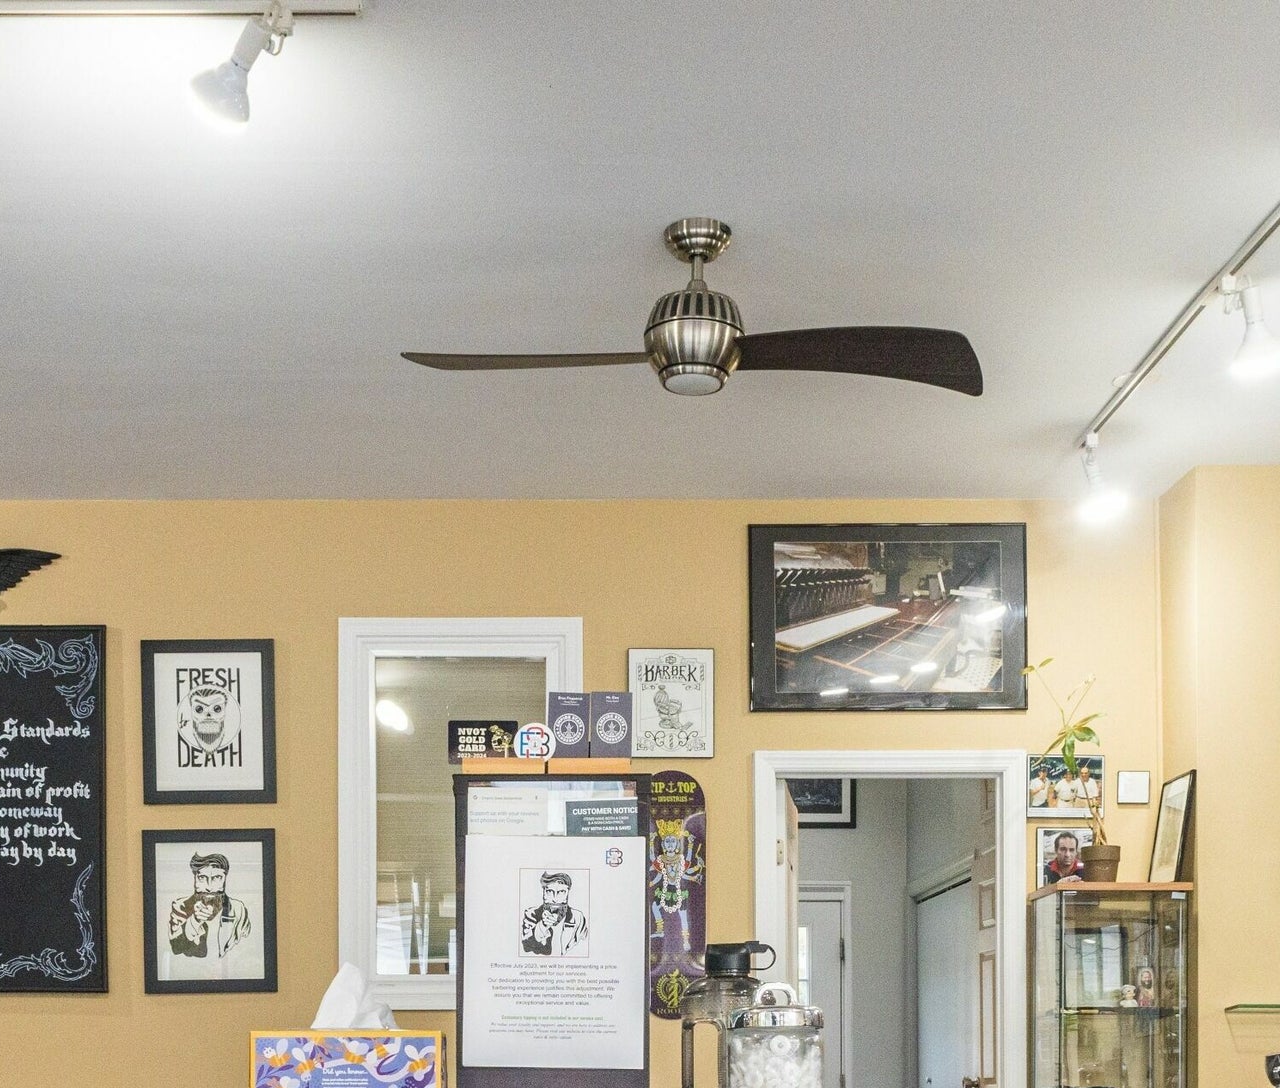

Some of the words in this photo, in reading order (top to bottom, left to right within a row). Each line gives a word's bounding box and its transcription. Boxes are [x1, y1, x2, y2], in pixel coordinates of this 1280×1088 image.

[176, 668, 240, 706] FRESH
[457, 728, 487, 736] NVOT
[458, 736, 486, 744] GOLD
[177, 730, 242, 768] DEATH
[458, 744, 486, 752] CARD
[25, 779, 44, 798] of
[45, 781, 91, 806] profit
[677, 781, 697, 793] TOP
[13, 822, 31, 839] of
[32, 822, 82, 841] work
[22, 840, 44, 867] by
[47, 841, 78, 867] day
[565, 963, 600, 971] implementing
[531, 977, 555, 985] providing
[598, 978, 620, 986] possible
[322, 1067, 334, 1075] Did
[335, 1069, 347, 1077] you
